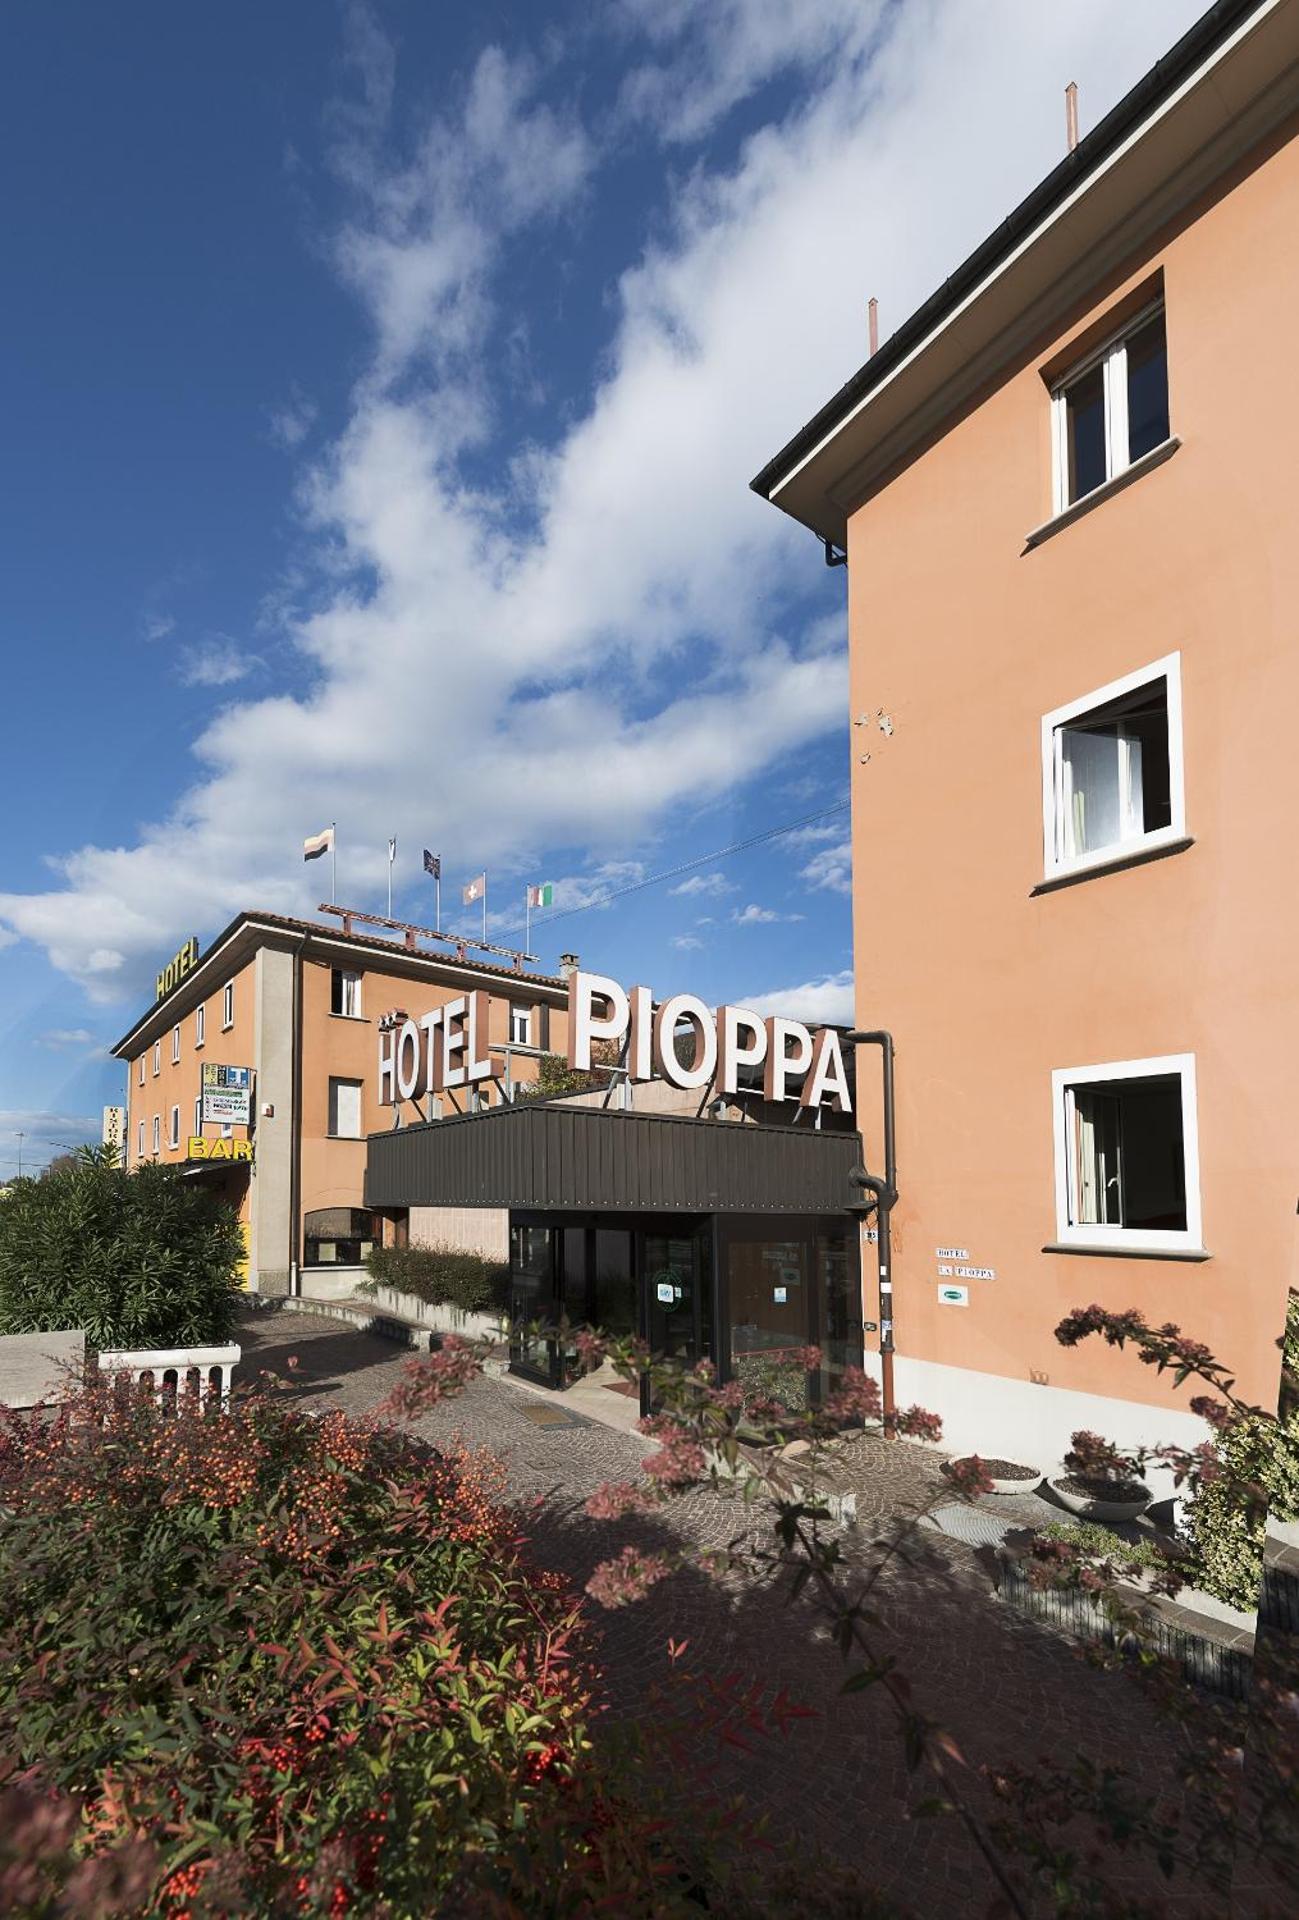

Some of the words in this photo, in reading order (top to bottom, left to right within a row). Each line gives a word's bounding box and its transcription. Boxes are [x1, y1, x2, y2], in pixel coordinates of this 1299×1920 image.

[156, 937, 199, 1001] HOTEL
[378, 990, 504, 1106] HOTEL
[568, 970, 852, 1112] PIOPPA
[188, 1136, 253, 1161] BAR
[938, 1249, 966, 1258] HOTEL
[957, 1267, 993, 1279] PIOPPA
